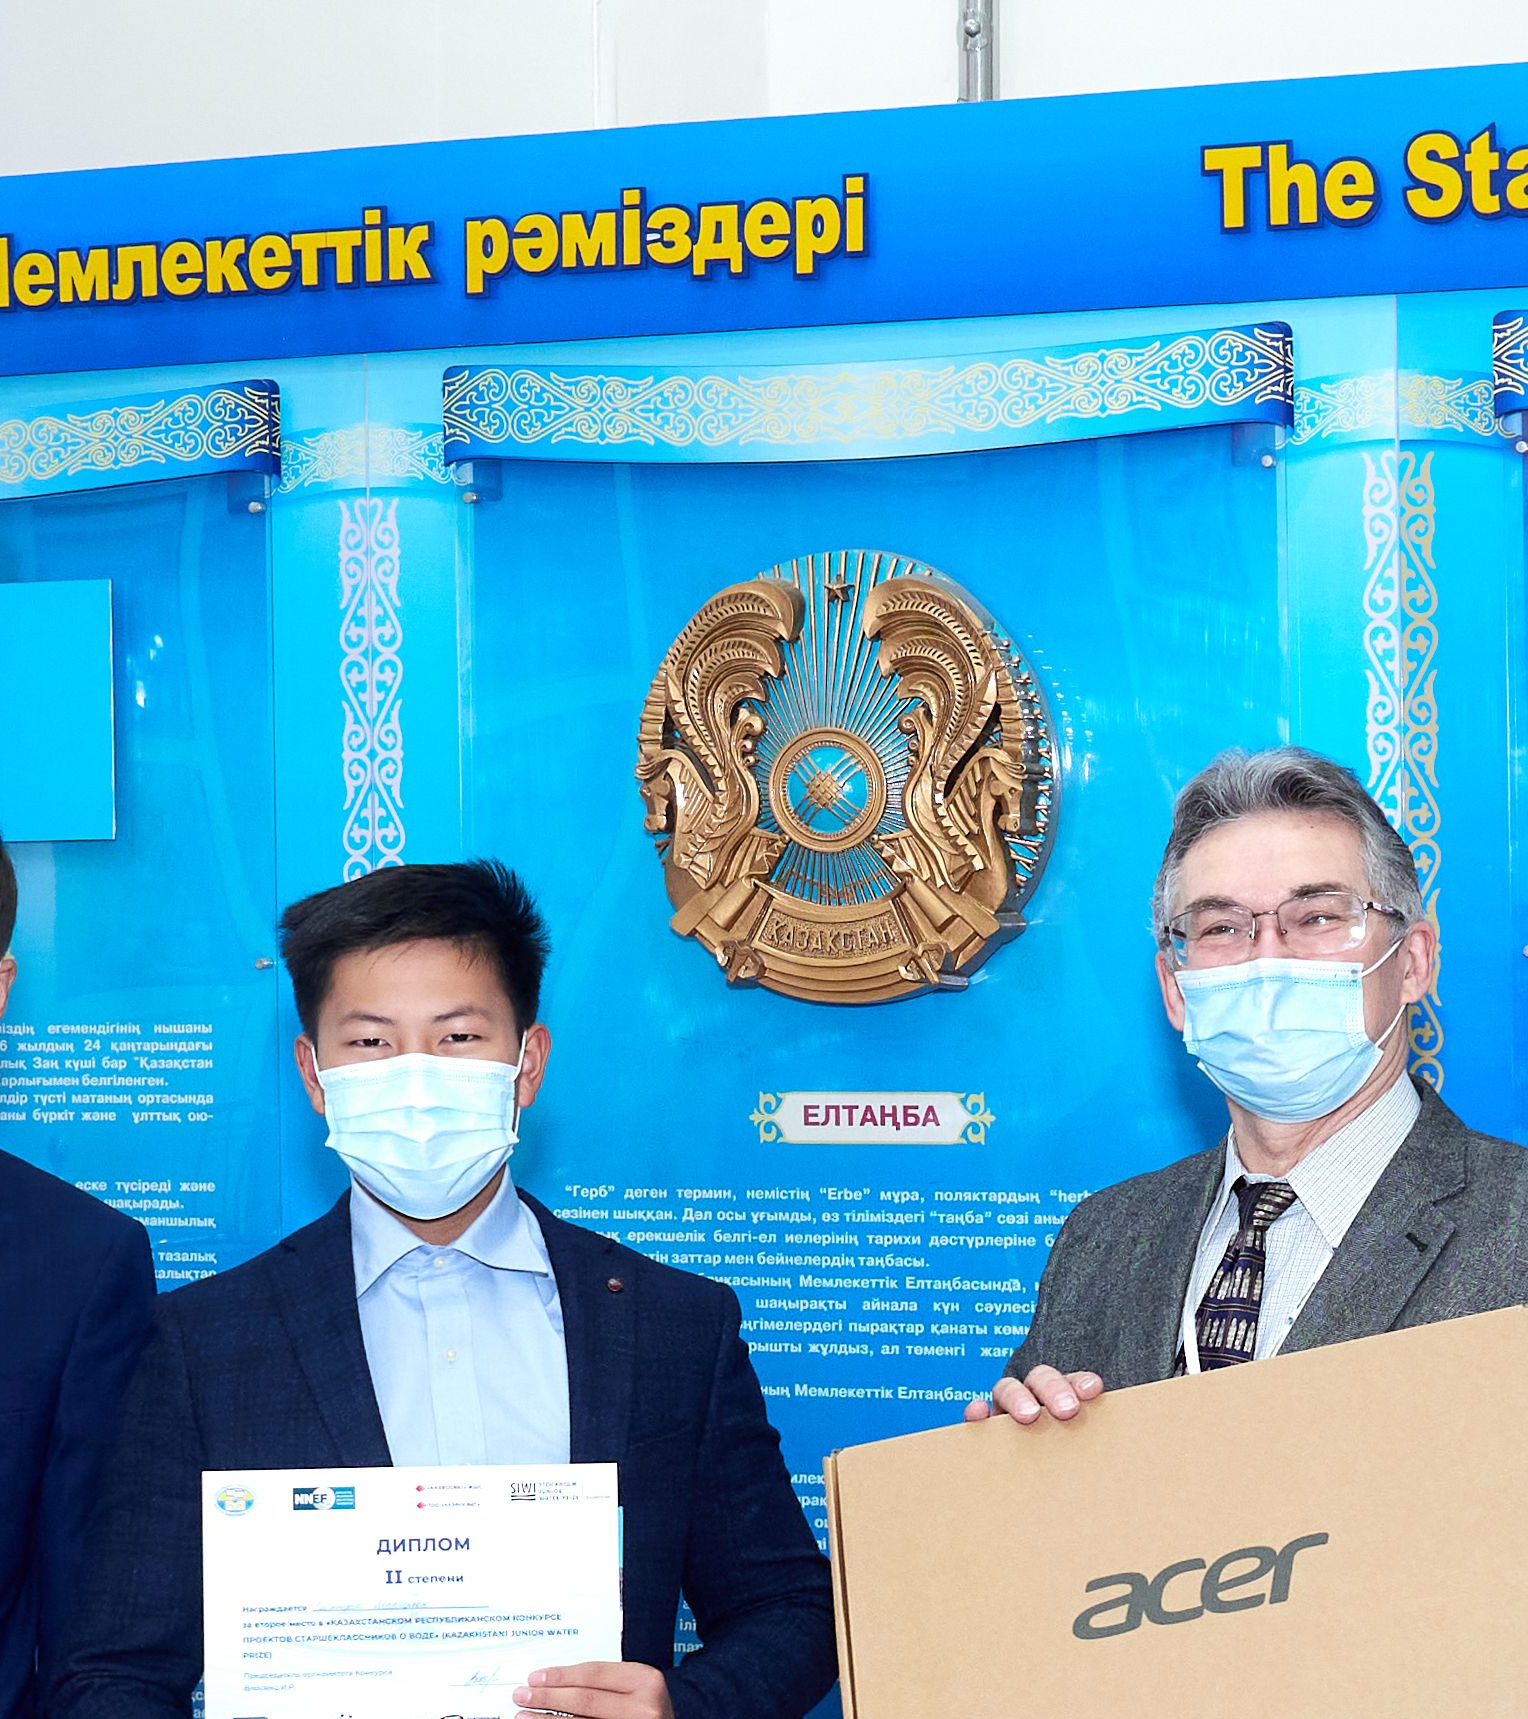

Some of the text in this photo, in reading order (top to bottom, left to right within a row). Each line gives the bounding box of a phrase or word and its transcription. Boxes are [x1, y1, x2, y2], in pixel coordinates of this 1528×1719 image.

[1203, 145, 1375, 228] The
[466, 179, 864, 292] рәміздері
[47, 1022, 213, 1035] егемендігінің нышаны
[17, 1042, 75, 1053] жылдың
[110, 1041, 213, 1053] қаңтарындағы
[64, 1055, 128, 1072] күші бар
[81, 1073, 169, 1087] белгіленген.
[32, 1091, 67, 1106] түсті
[71, 1094, 133, 1105] матаның
[137, 1093, 214, 1106] ортасында
[32, 1108, 76, 1124] бүркіт
[804, 1105, 940, 1131] ЕЛТАҢБА
[74, 1179, 172, 1194] еске түсіреді
[564, 1184, 1041, 1204] “Герб” деген термин, немістің “Erbe” мұра, поляктардың
[612, 1207, 1029, 1225] шыққан. Дәл осы ұғымды, өз тіліміздегі “таңба” сөзі
[626, 1230, 706, 1244] ерекшелік
[713, 1229, 777, 1243] белгі-ел
[784, 1232, 859, 1247] иелерінің
[866, 1234, 921, 1248] тарихи
[928, 1234, 1037, 1249] дәстүрлеріне
[157, 1251, 218, 1264] тазалық
[671, 1251, 930, 1268] заттар мен бейнелердің таңбасы.
[799, 1274, 898, 1289] Мемлекеттік
[755, 1298, 960, 1315] шаңырақты айнала күн
[848, 1322, 988, 1336] пырақтар қанаты
[808, 1343, 966, 1357] жұлдыз, төменгі
[794, 1383, 894, 1399] Мемлекеттік
[510, 1482, 537, 1495] SIWI
[376, 1537, 470, 1555] ДИПЛОМ
[385, 1570, 465, 1584] II степени
[1072, 1531, 1330, 1639] acer
